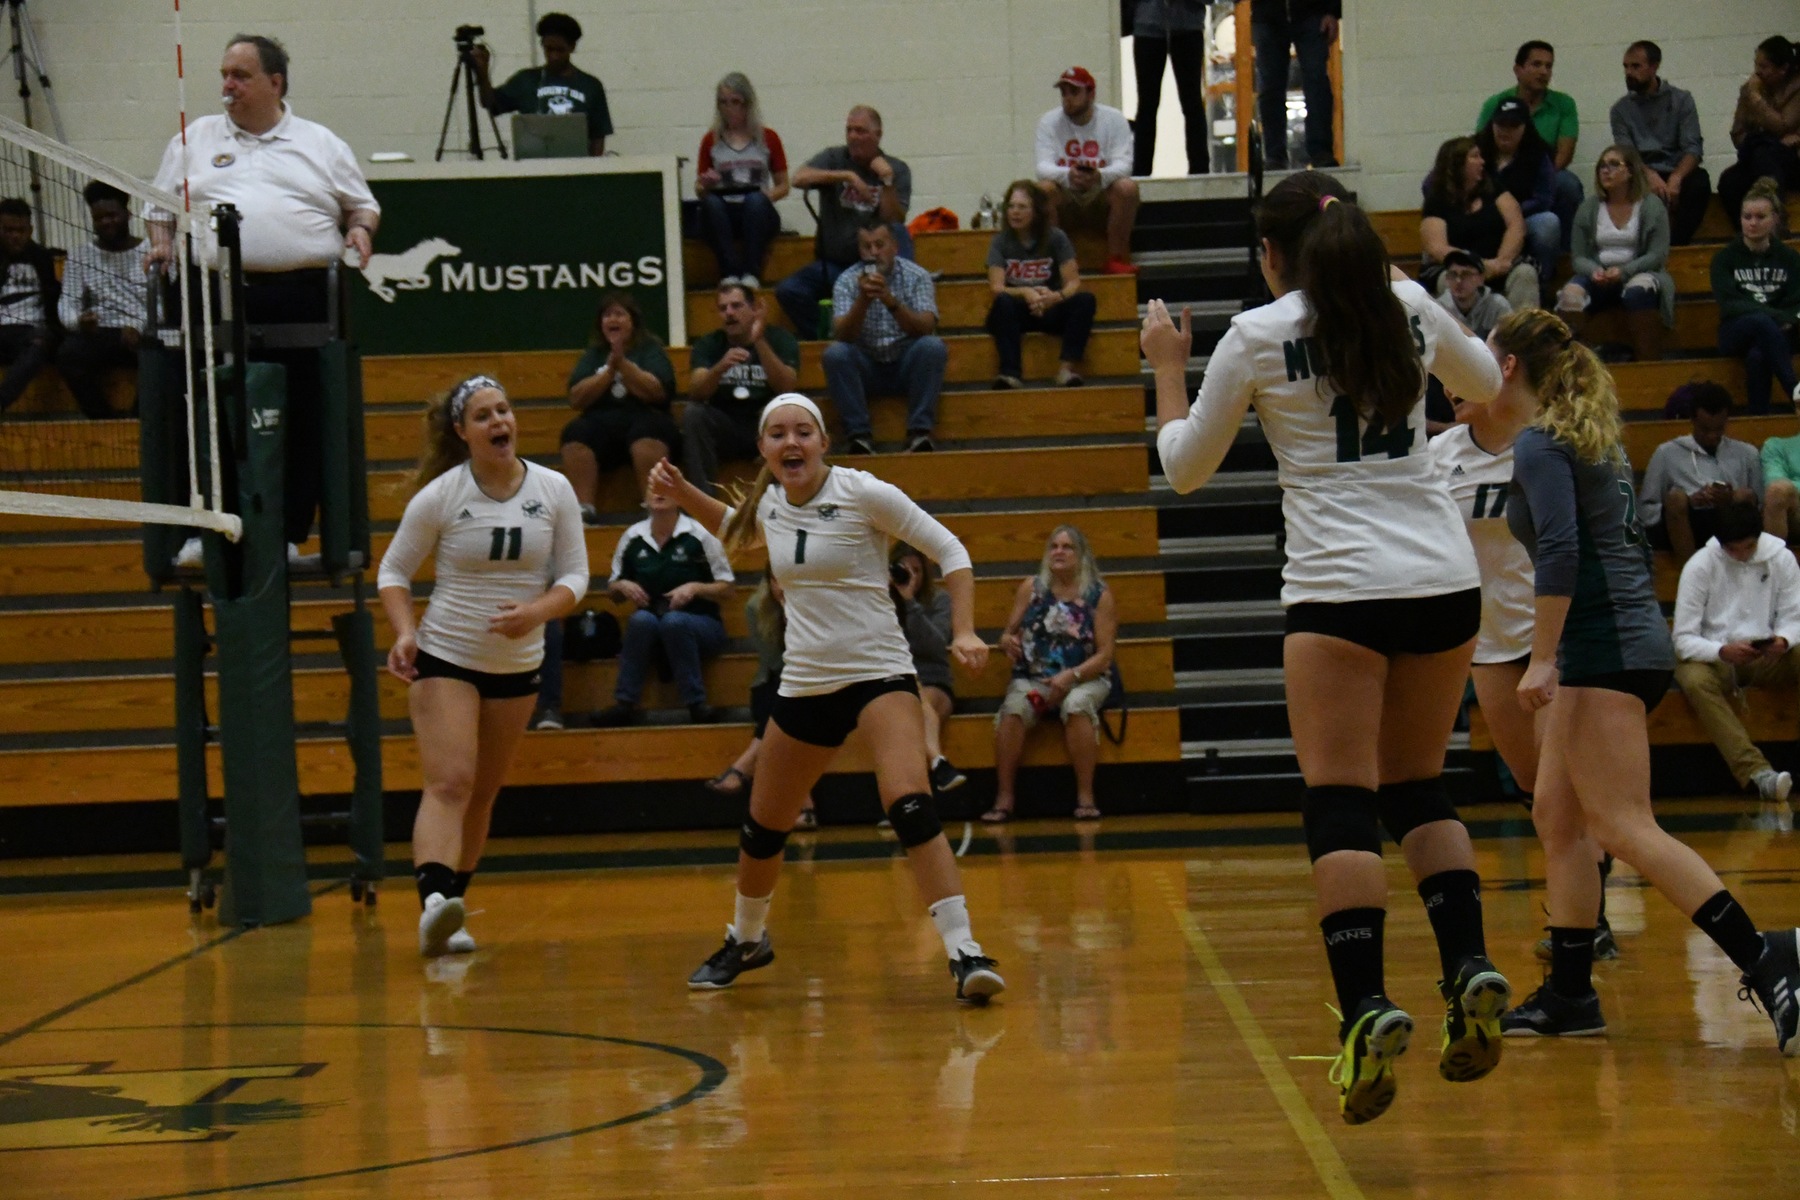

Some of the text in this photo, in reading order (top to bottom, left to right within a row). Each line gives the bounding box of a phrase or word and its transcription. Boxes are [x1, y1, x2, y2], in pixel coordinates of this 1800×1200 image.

[440, 255, 663, 293] MUSTANGS
[1329, 394, 1415, 462] 14
[1472, 483, 1511, 518] 17
[489, 527, 522, 561] 11
[795, 528, 807, 564] 1
[1326, 927, 1373, 946] VANS
